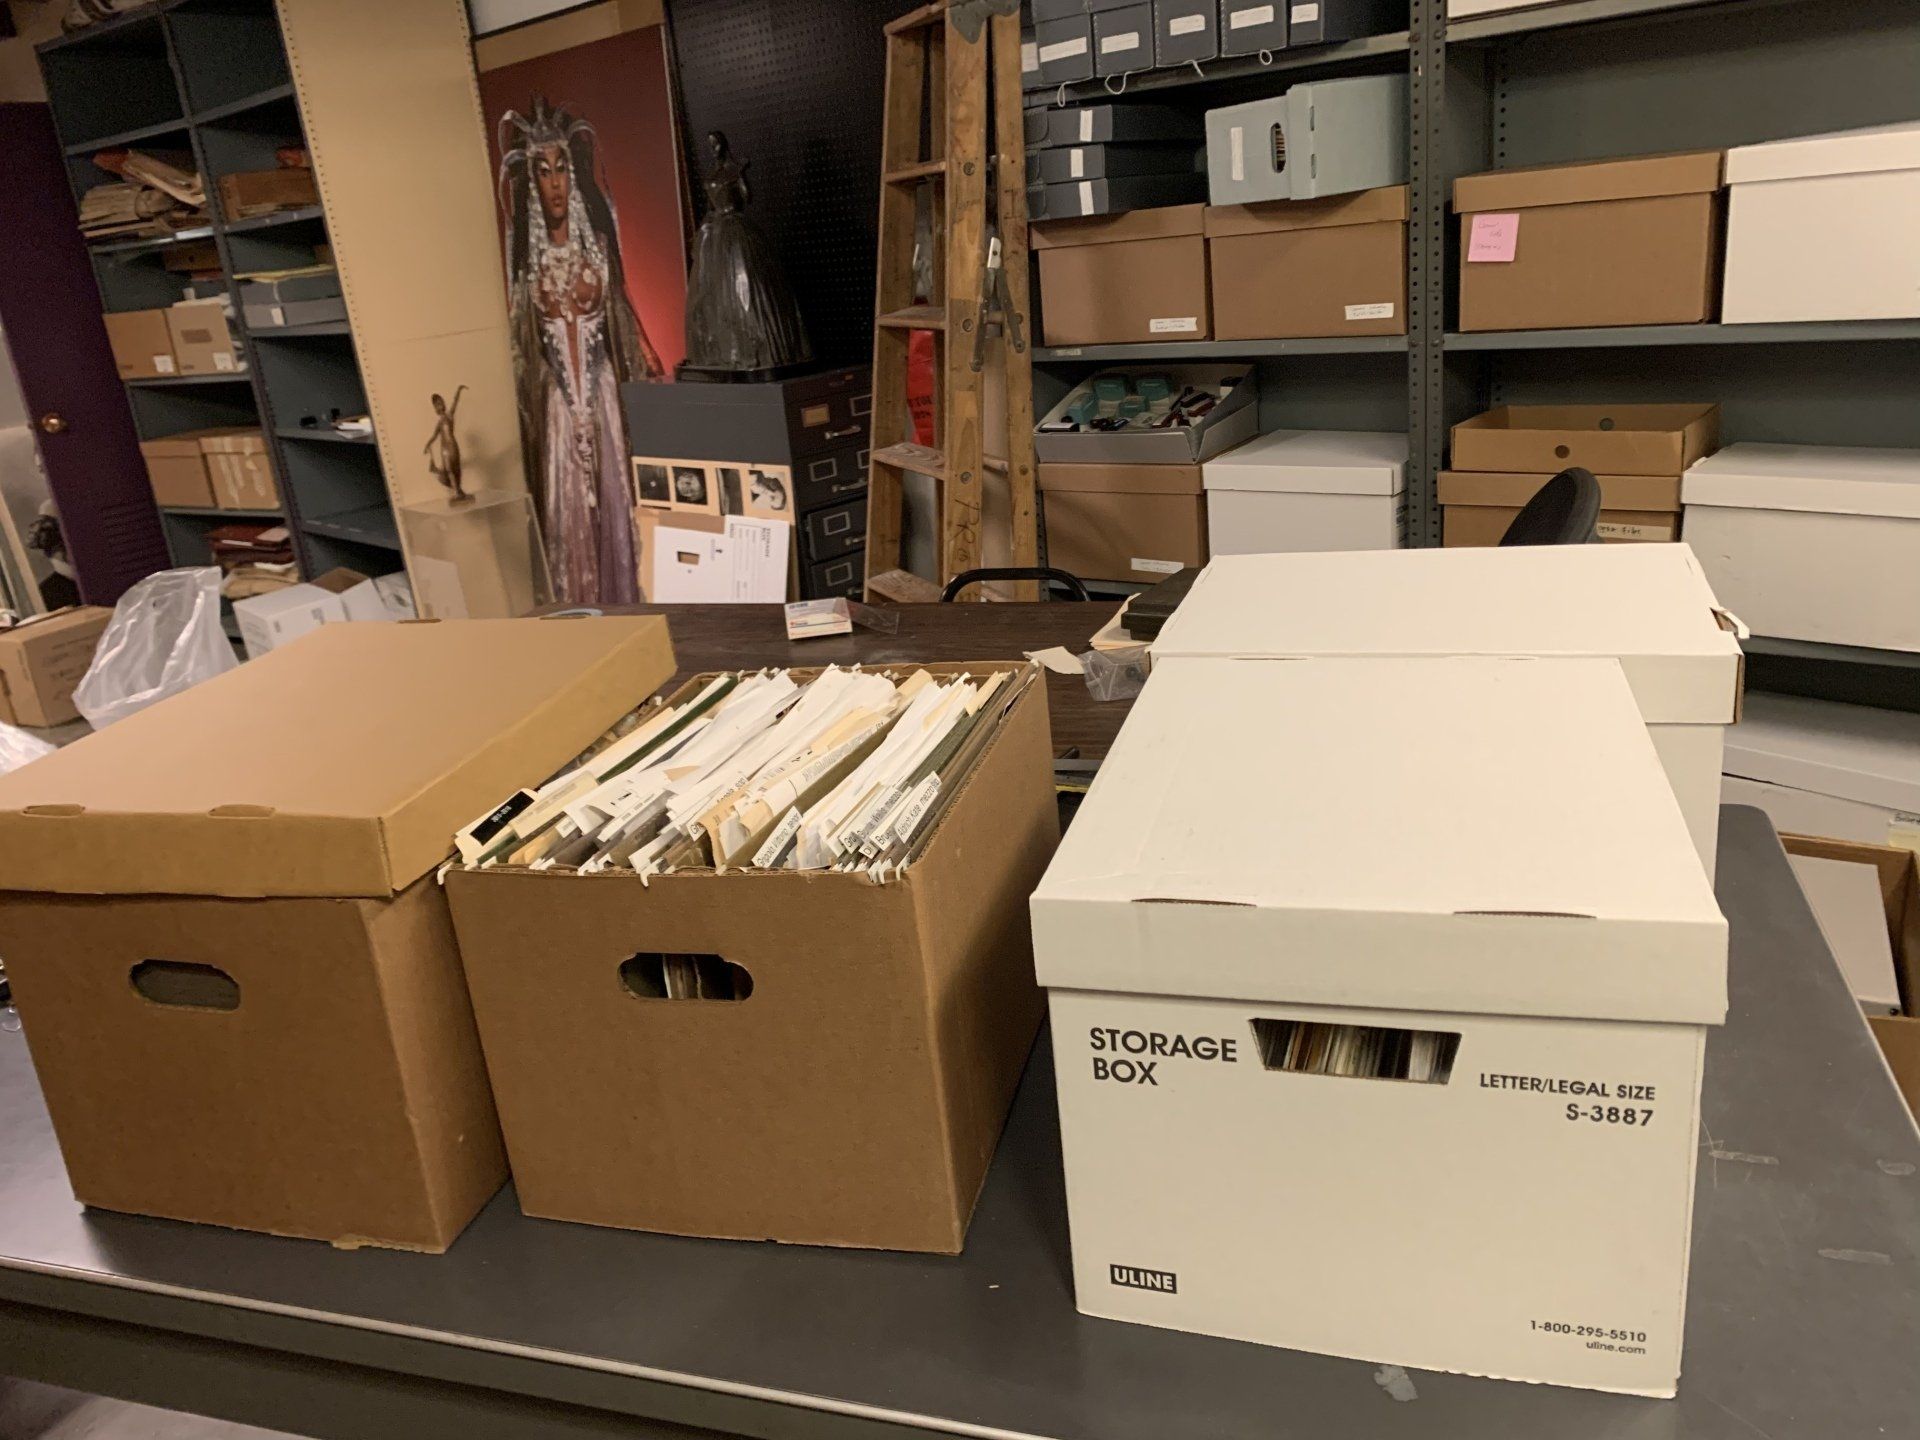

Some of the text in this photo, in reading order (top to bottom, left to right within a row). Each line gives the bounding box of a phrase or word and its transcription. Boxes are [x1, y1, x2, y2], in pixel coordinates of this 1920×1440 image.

[1090, 1027, 1237, 1063] STORAGE
[1092, 1057, 1158, 1086] BOX
[1480, 1073, 1656, 1101] LETTER/LEGAL SIZE
[1566, 1103, 1654, 1127] S-3887
[1112, 1266, 1174, 1292] ULINE
[1530, 1320, 1647, 1343] 1-800-295-5510
[1586, 1341, 1646, 1354] uline.com
